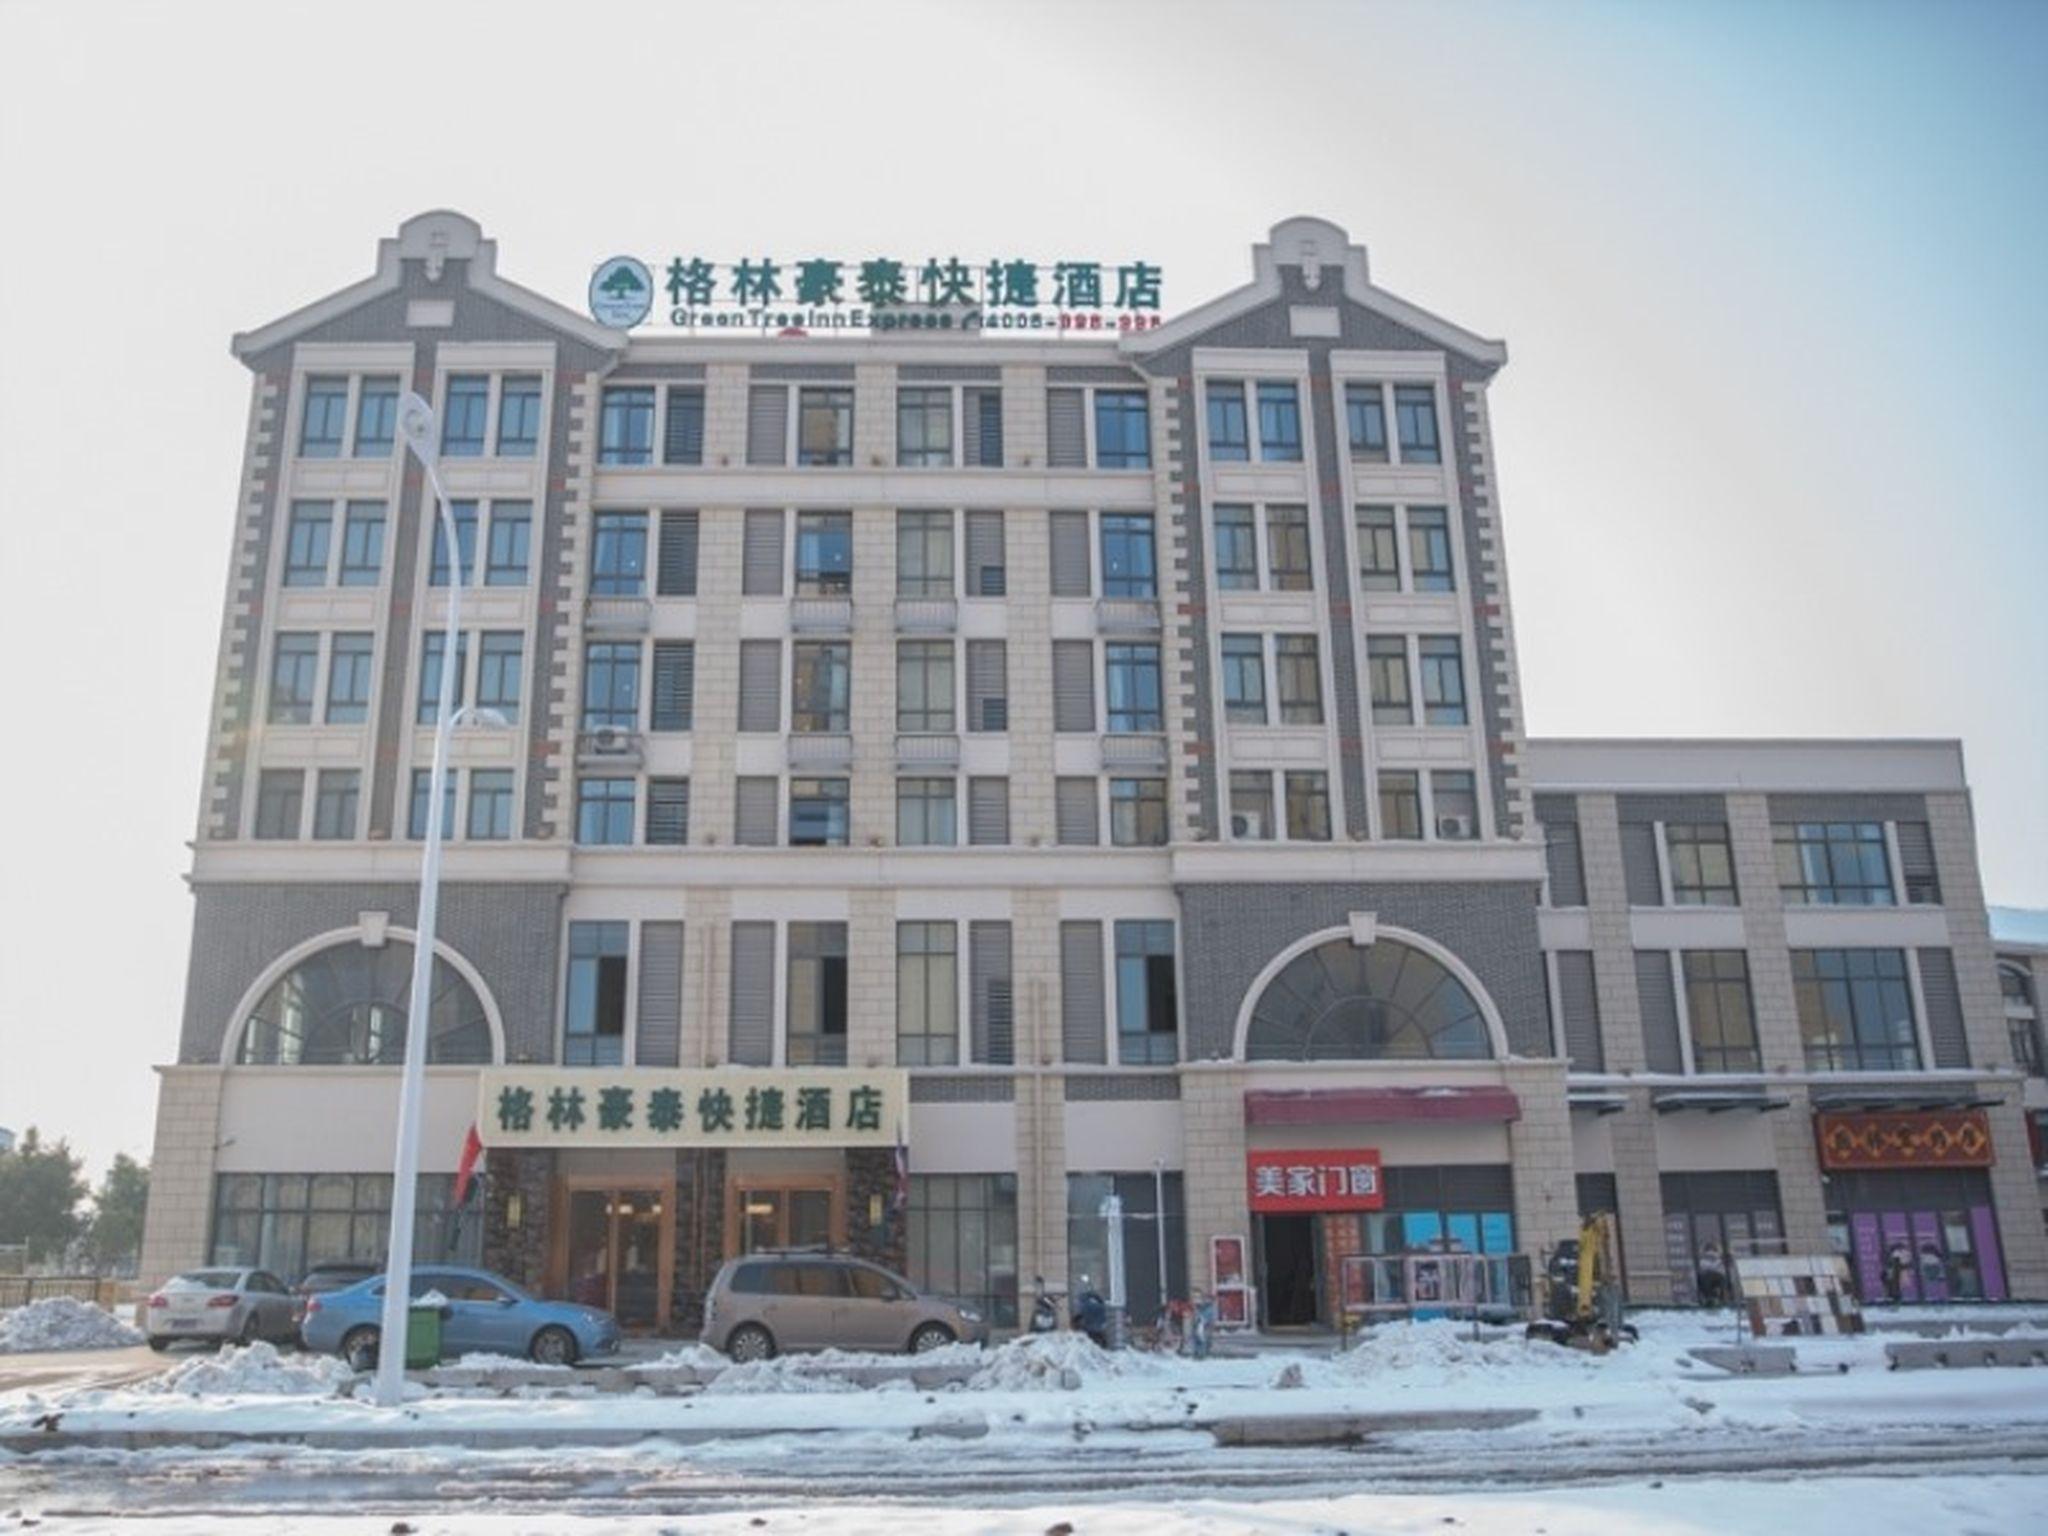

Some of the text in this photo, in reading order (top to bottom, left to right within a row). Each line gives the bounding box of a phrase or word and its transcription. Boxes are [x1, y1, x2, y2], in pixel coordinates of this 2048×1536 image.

[666, 258, 1162, 308] 格林豪泰快捷酒店
[497, 1085, 882, 1132] 格林豪泰快捷酒店
[1256, 1165, 1377, 1196] 美家门窗
